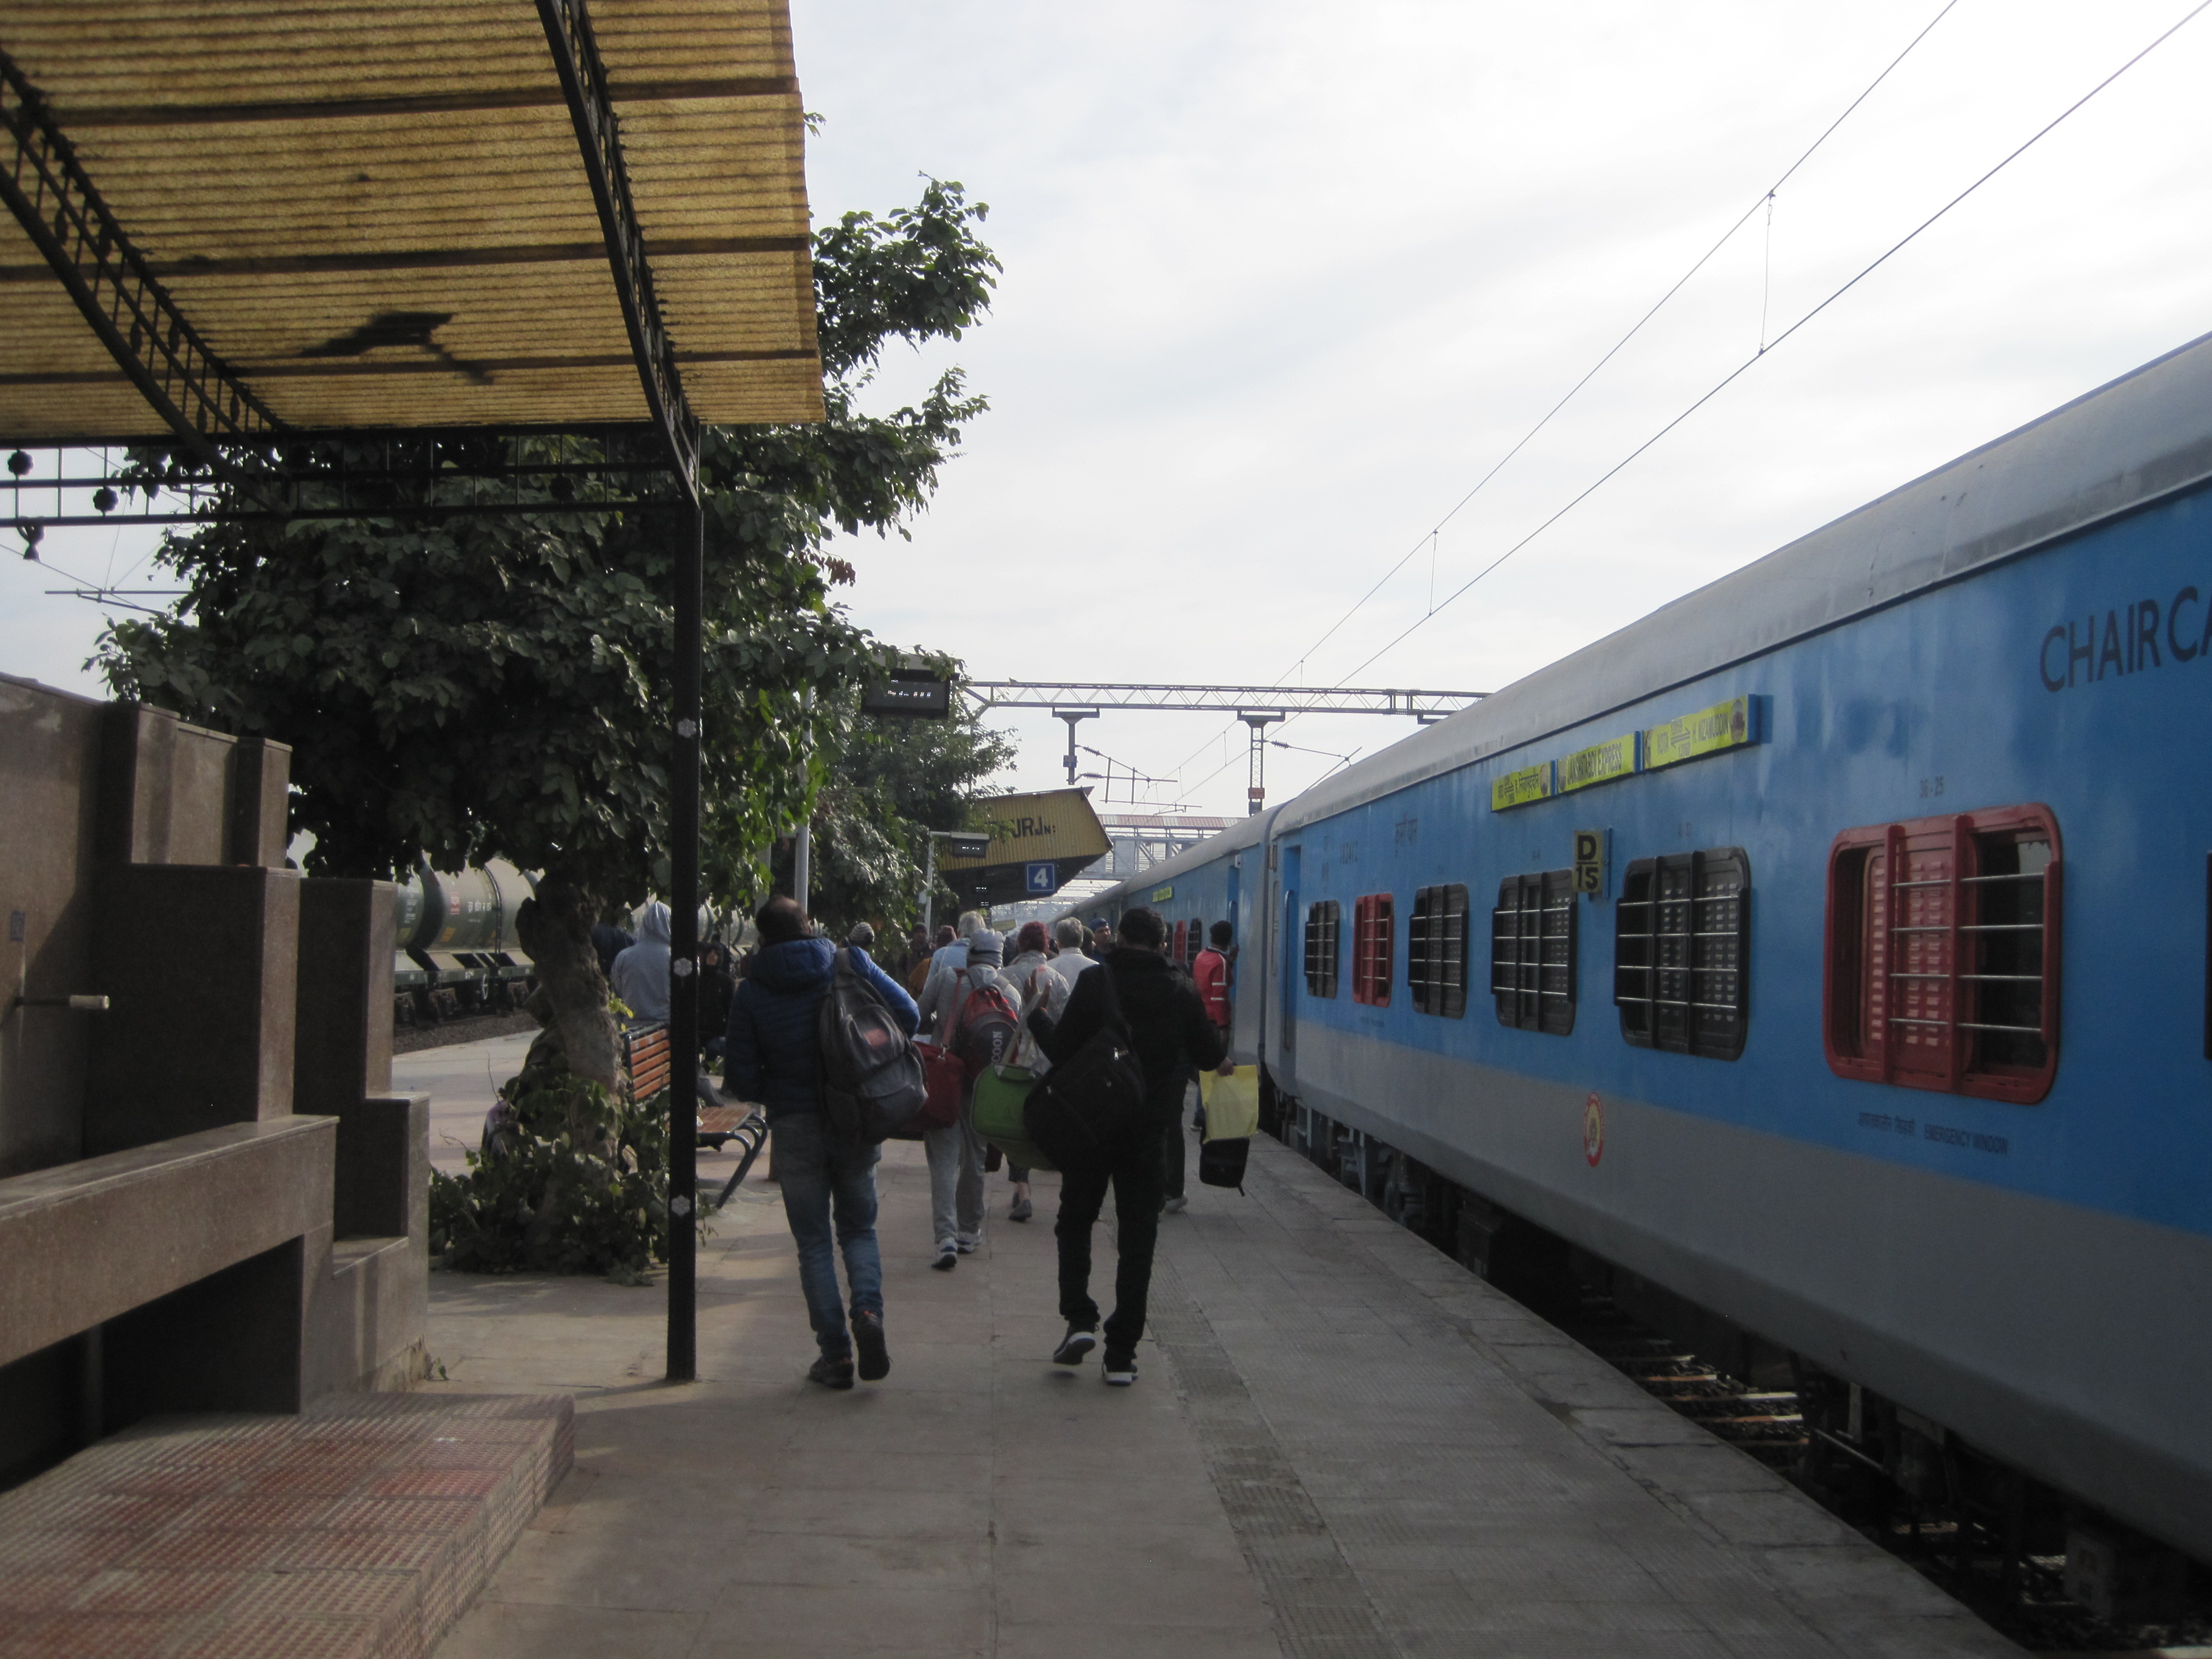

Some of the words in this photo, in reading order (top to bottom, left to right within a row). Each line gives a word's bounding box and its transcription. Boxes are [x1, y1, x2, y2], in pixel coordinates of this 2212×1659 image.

[1578, 835, 1597, 861] D
[1034, 868, 1048, 887] 4
[1577, 865, 1598, 890] 15
[991, 1031, 1002, 1065] COON
